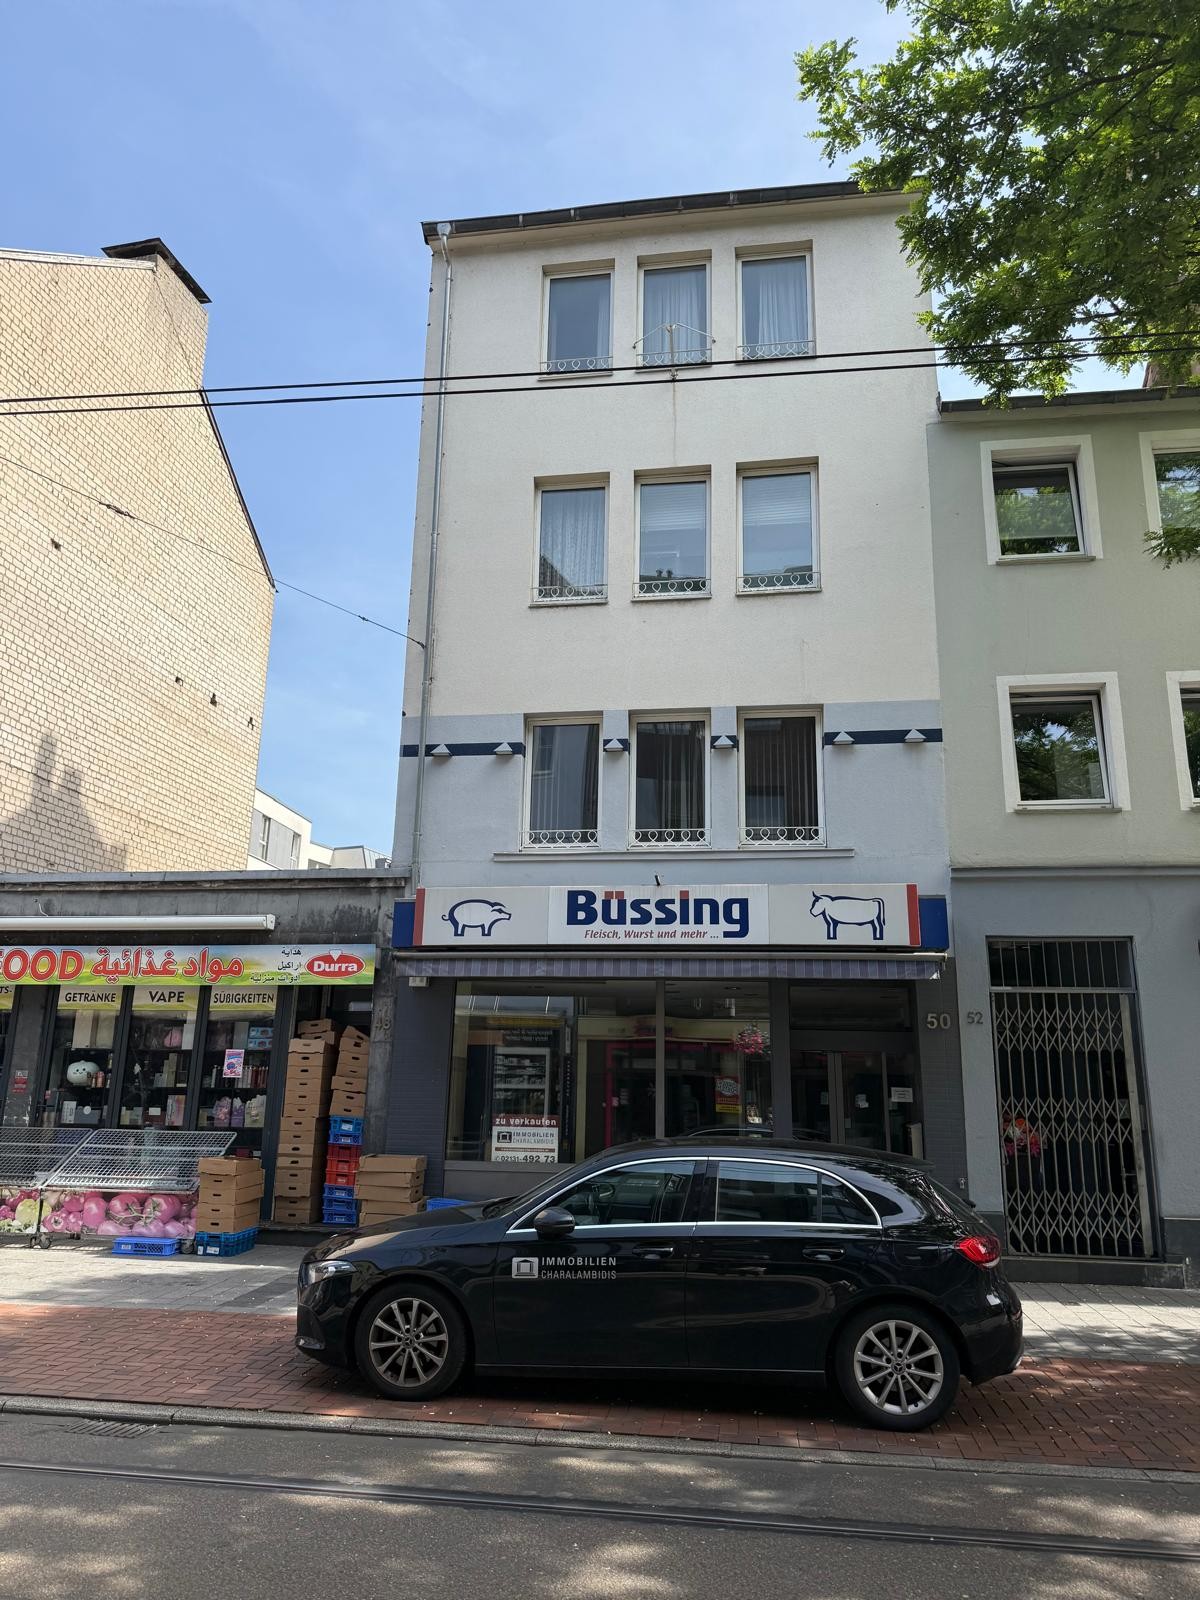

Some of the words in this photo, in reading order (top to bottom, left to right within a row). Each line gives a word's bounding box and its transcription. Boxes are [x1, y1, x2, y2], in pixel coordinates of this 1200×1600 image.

[567, 890, 749, 938] Büssing
[584, 929, 621, 939] Fleisch,
[624, 930, 654, 938] Wurst
[657, 929, 677, 938] und
[680, 929, 708, 938] mehr
[0, 948, 84, 981] OOD
[90, 947, 177, 984] غذائية
[182, 947, 244, 983] مواد
[313, 960, 358, 972] Durra
[64, 989, 117, 1003] GETRÄNKE
[149, 990, 185, 1003] VAPE
[926, 1013, 951, 1029] 50
[967, 1011, 984, 1025] 52
[509, 1117, 557, 1126] verkaufen
[544, 1155, 555, 1163] 73
[541, 1257, 617, 1266] IMMOBILIEN
[541, 1270, 617, 1279] CHARALAMBIDIS
